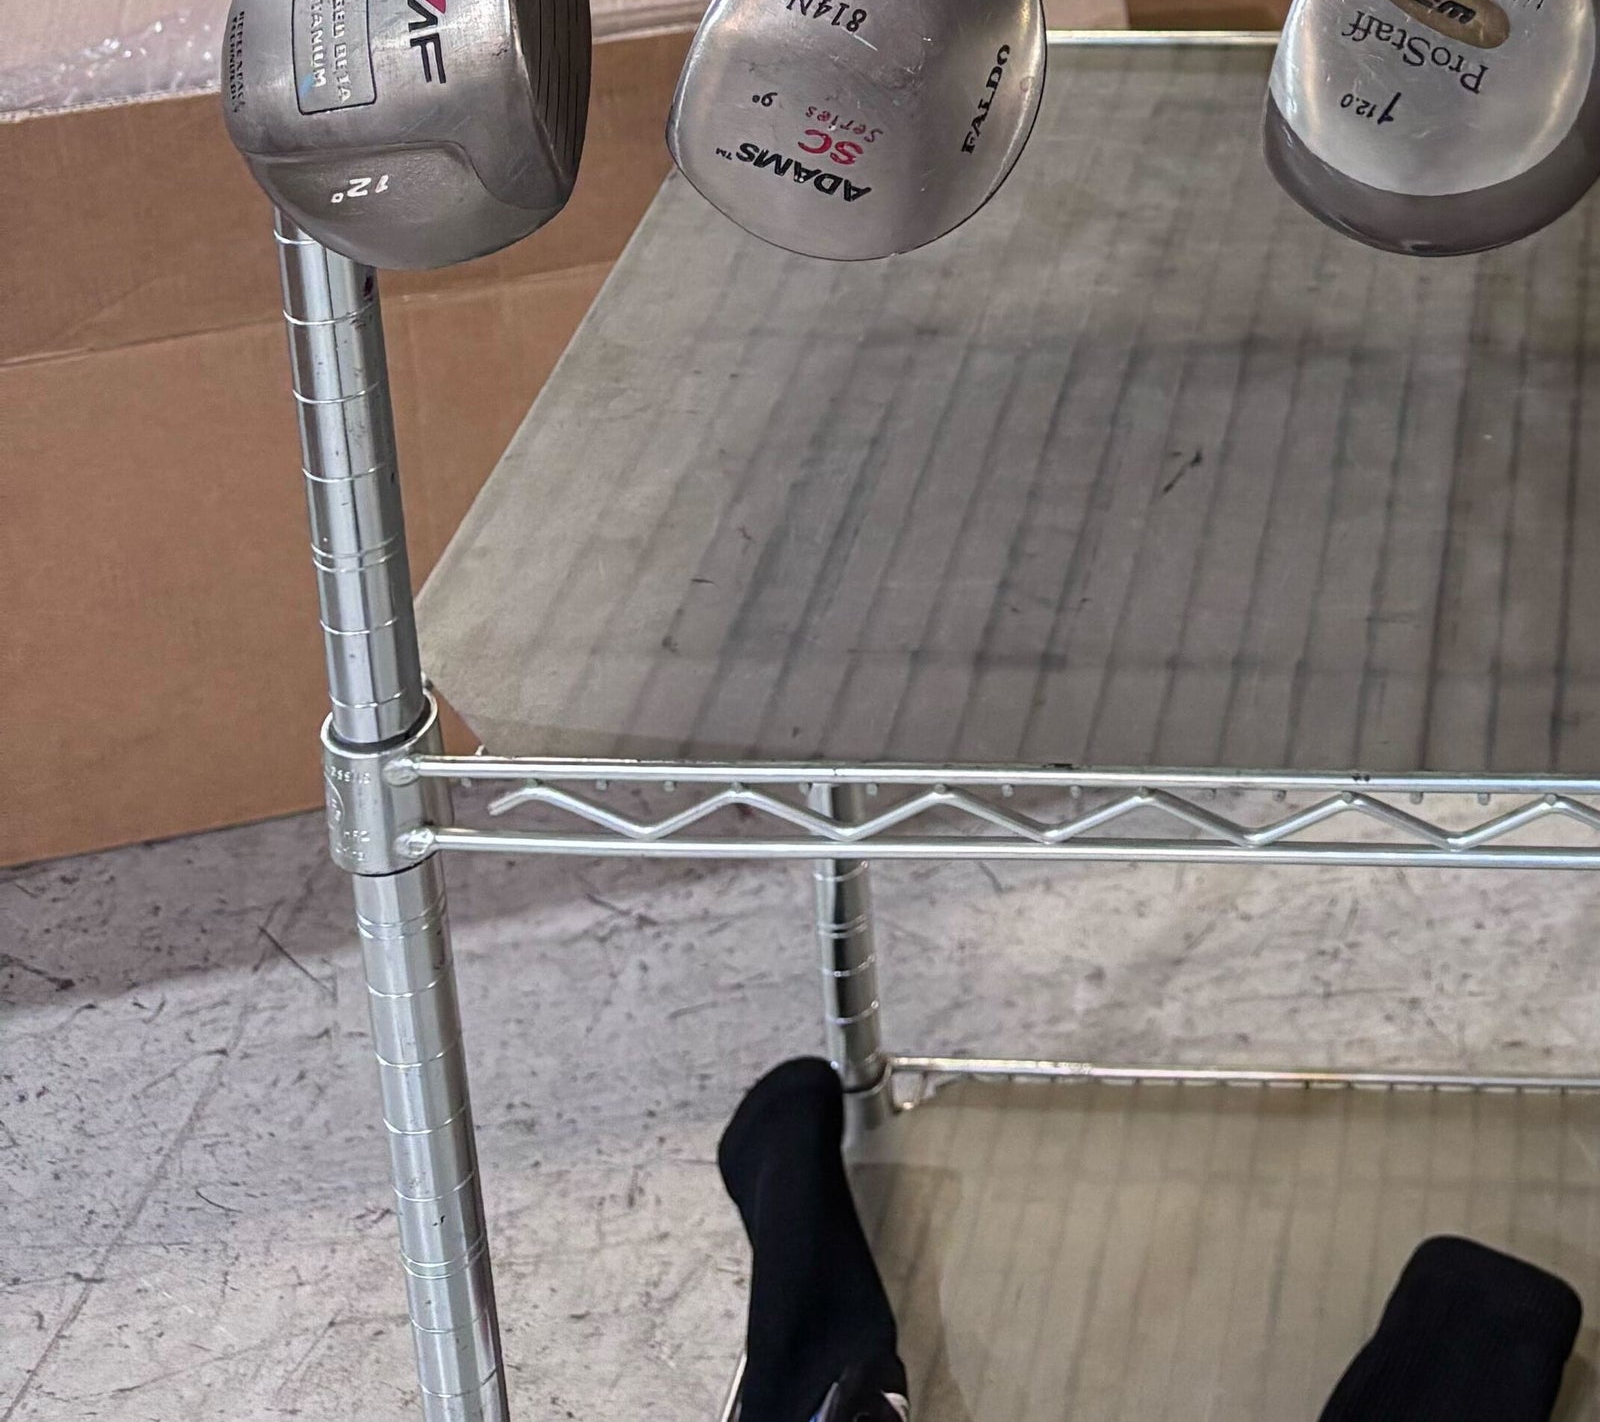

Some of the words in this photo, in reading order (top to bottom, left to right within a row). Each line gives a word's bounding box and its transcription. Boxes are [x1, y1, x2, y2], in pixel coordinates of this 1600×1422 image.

[336, 40, 352, 104] BETA
[1341, 9, 1489, 95] ProStaff
[961, 44, 1011, 155] FALDO
[798, 128, 864, 165] SC
